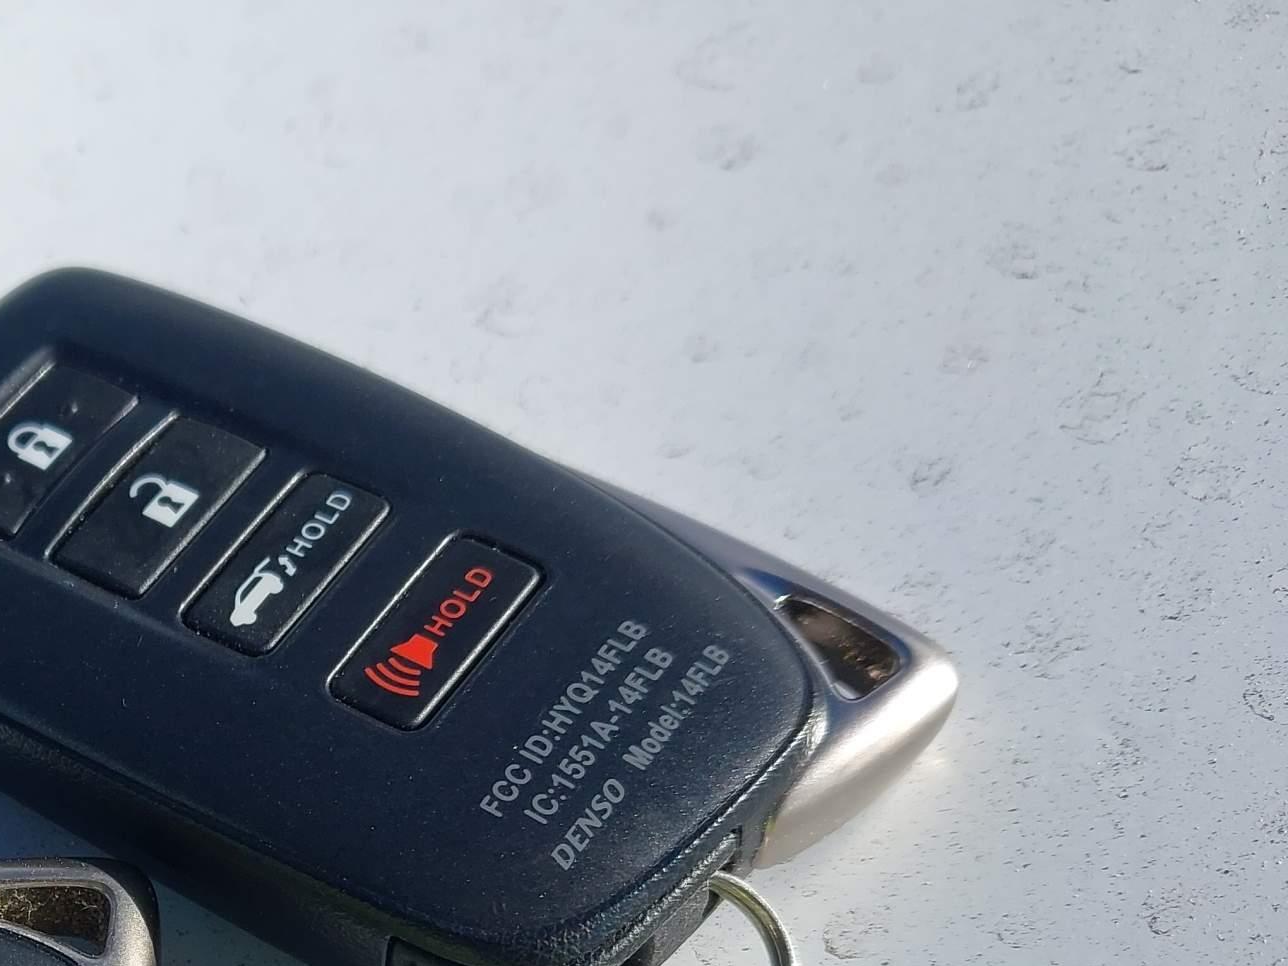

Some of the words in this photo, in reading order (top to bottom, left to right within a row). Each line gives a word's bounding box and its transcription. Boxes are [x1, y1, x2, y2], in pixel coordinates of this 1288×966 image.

[286, 491, 352, 558] HOLD
[424, 567, 494, 636] HOLD
[479, 763, 532, 818] FCC
[519, 620, 647, 764] ID:HYQ14FLB
[524, 648, 674, 824] IC:1551A-14FLB
[551, 778, 626, 871] DENSO
[622, 644, 730, 770] Model:14FLB
